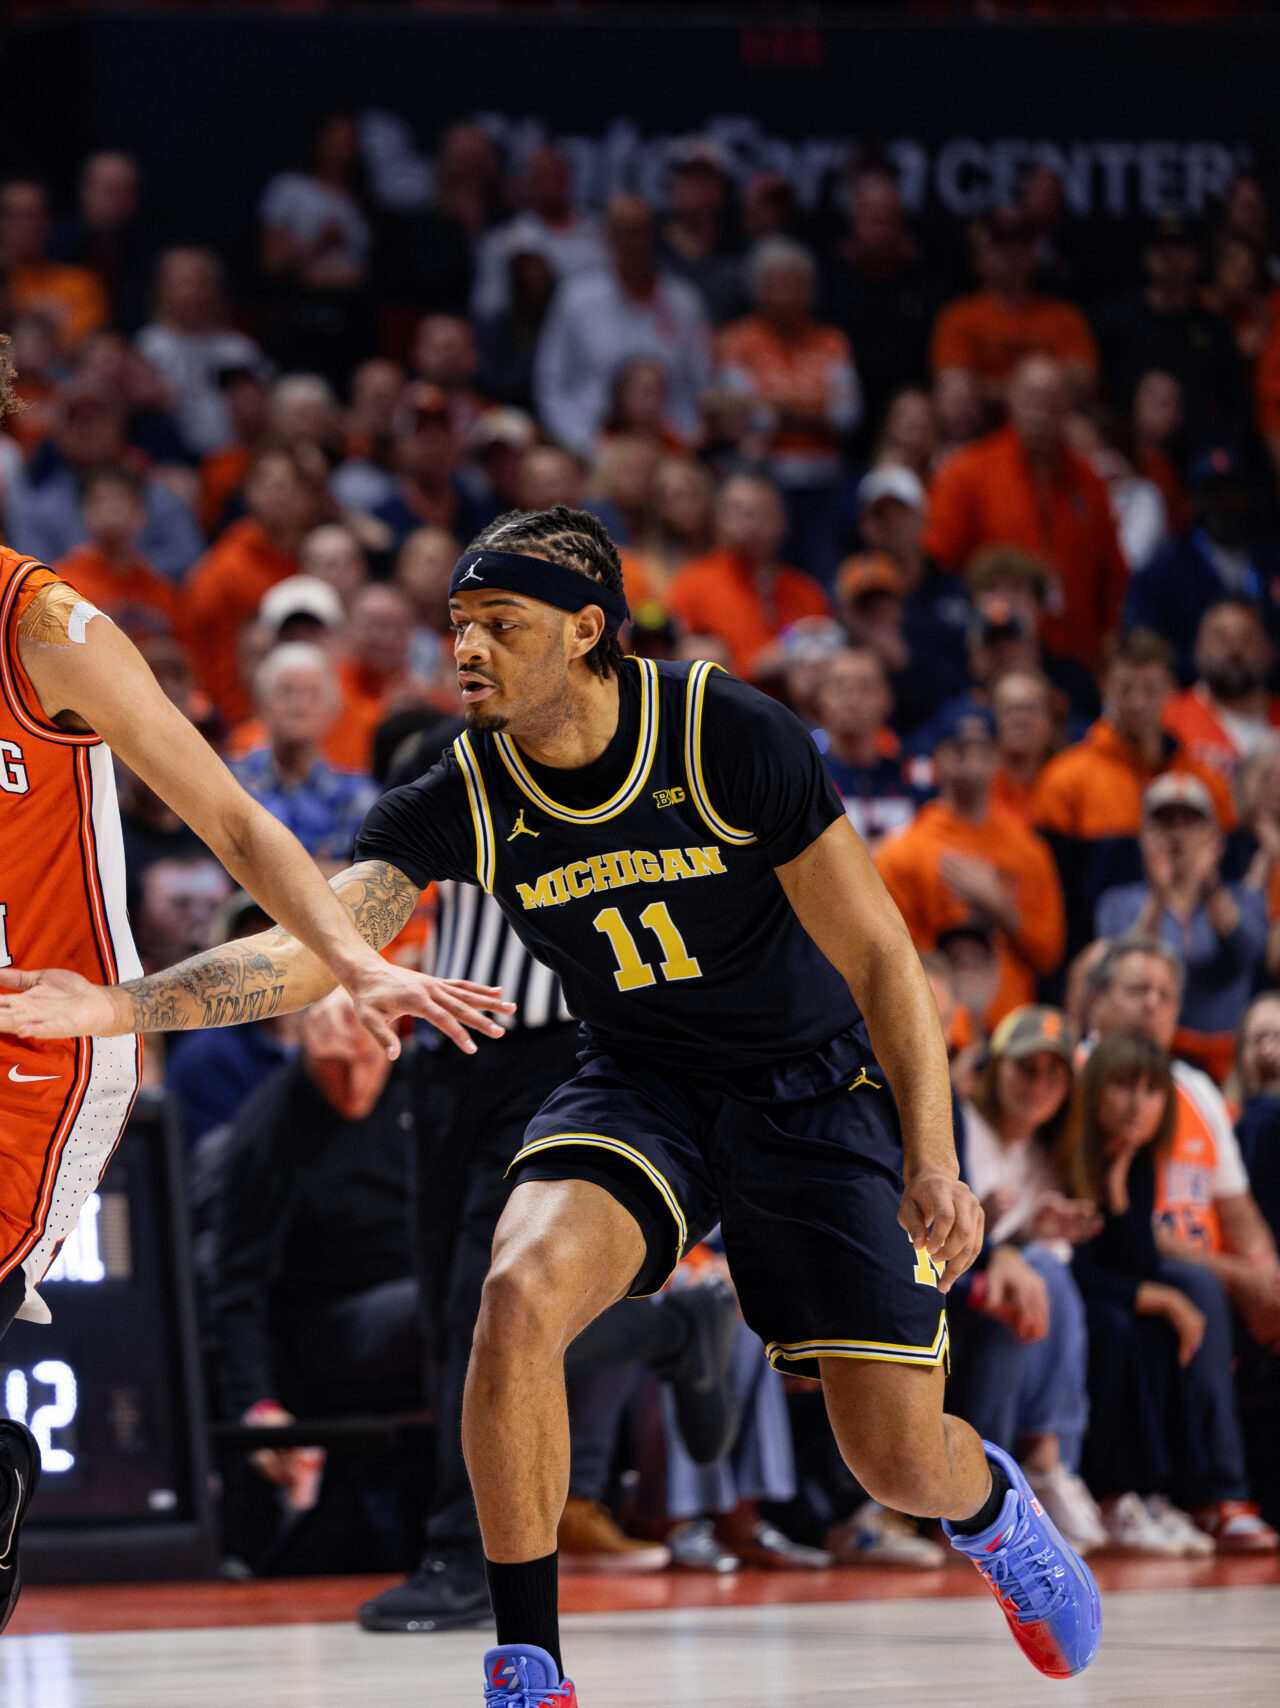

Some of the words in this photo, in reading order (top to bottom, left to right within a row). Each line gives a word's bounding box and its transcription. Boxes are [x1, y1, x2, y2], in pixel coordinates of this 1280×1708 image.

[936, 137, 1234, 217] CENTER
[515, 846, 728, 910] MICHIGAN
[592, 901, 703, 992] 11
